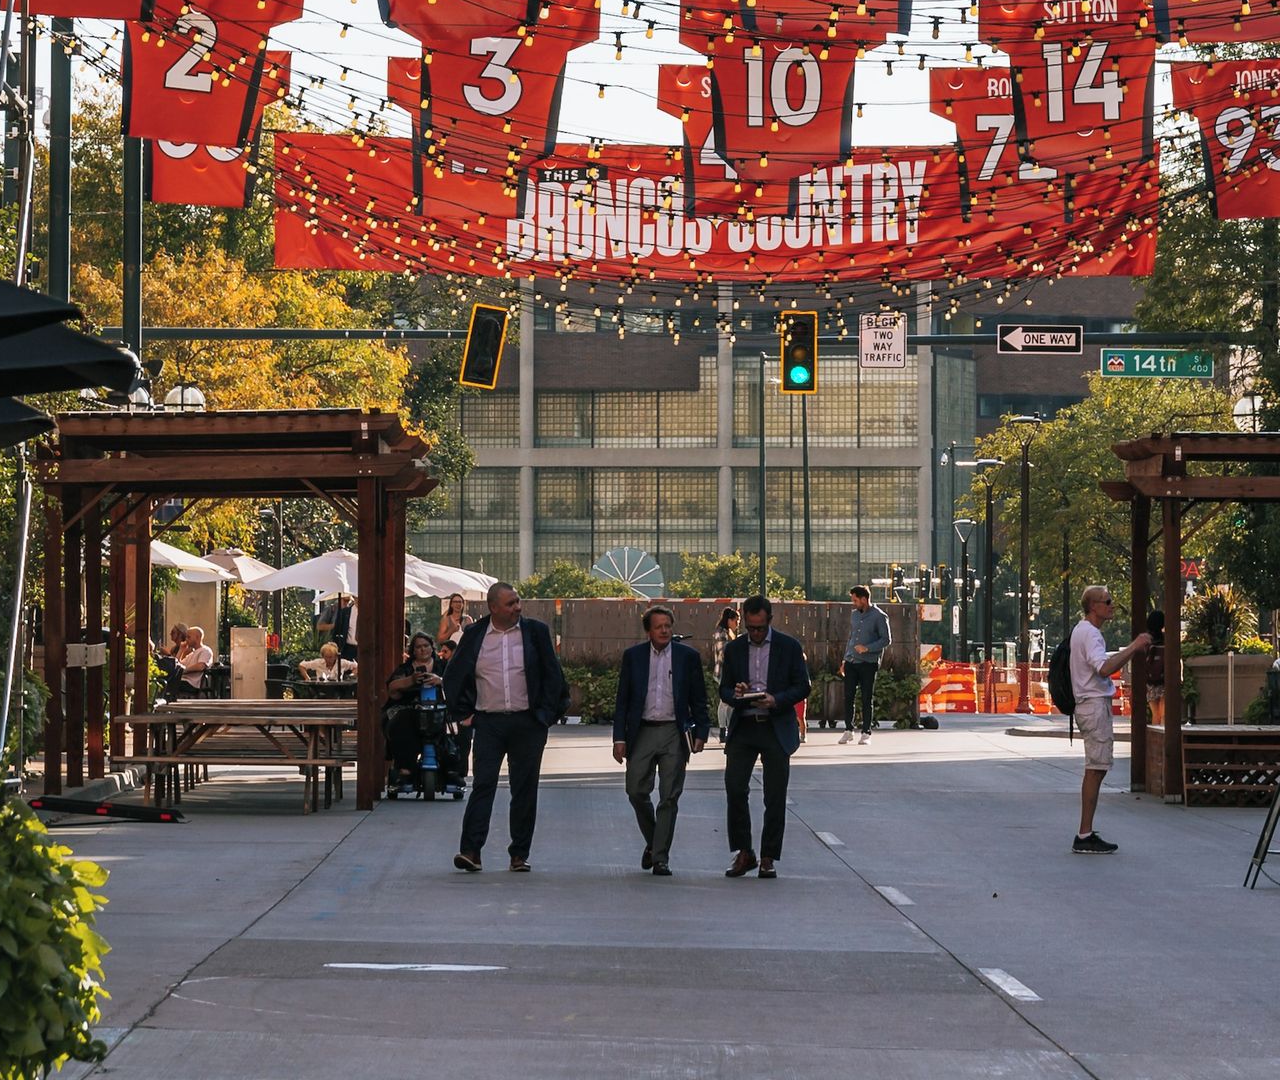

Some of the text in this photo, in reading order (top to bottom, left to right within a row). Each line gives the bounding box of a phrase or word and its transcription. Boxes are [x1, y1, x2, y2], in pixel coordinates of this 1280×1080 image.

[163, 12, 218, 94] 2
[462, 36, 523, 116] 3
[1040, 40, 1124, 123] 14
[742, 46, 823, 128] 10
[976, 114, 1059, 181] 7
[544, 170, 579, 182] THIS
[874, 331, 894, 340] TWO
[1024, 333, 1073, 345] ONE WAY
[873, 342, 893, 351] WAY
[864, 353, 902, 362] TRAFFIC
[1134, 354, 1177, 373] 14th
